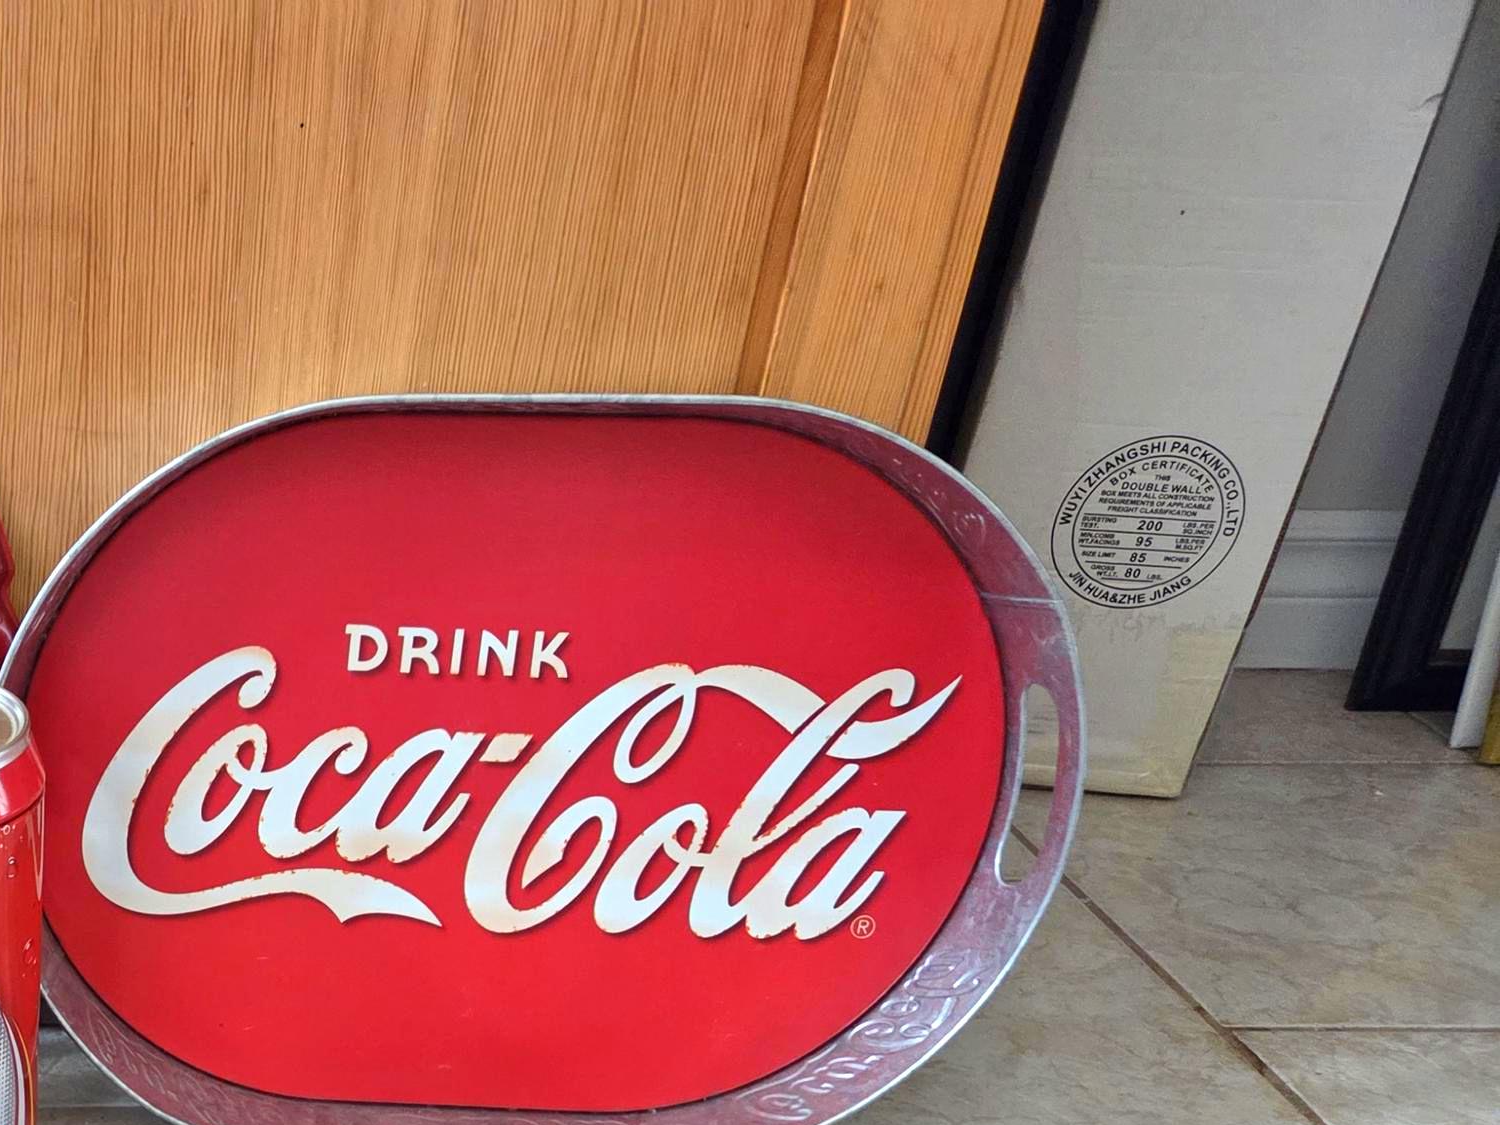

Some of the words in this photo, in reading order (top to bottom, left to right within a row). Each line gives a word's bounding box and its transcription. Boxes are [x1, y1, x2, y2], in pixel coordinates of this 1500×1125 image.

[1059, 487, 1088, 526] WUYI
[1084, 441, 1168, 488] ZHANGSHI
[1170, 440, 1231, 481] PACKING
[1109, 466, 1137, 487] BOX
[1141, 460, 1215, 494] CERTIFICATE
[1121, 481, 1169, 493] DOUBLE
[1171, 484, 1202, 495] WALL
[1142, 492, 1157, 500] ALL
[1158, 493, 1215, 502] CONSTRUCTION
[1098, 498, 1155, 507] REQUIREMENTS
[1166, 501, 1212, 510] APPLICABLE
[1107, 505, 1139, 513] FREIGHT
[1139, 507, 1197, 517] CLASSIFICATION
[1136, 520, 1163, 531] 200
[1135, 536, 1154, 547] 95
[1129, 552, 1147, 563] 85
[1124, 568, 1141, 579] 80
[1068, 570, 1086, 591] JIN
[1149, 576, 1192, 602] JIANG
[345, 623, 570, 679] DRINK
[81, 645, 963, 941] Coca-Cola
